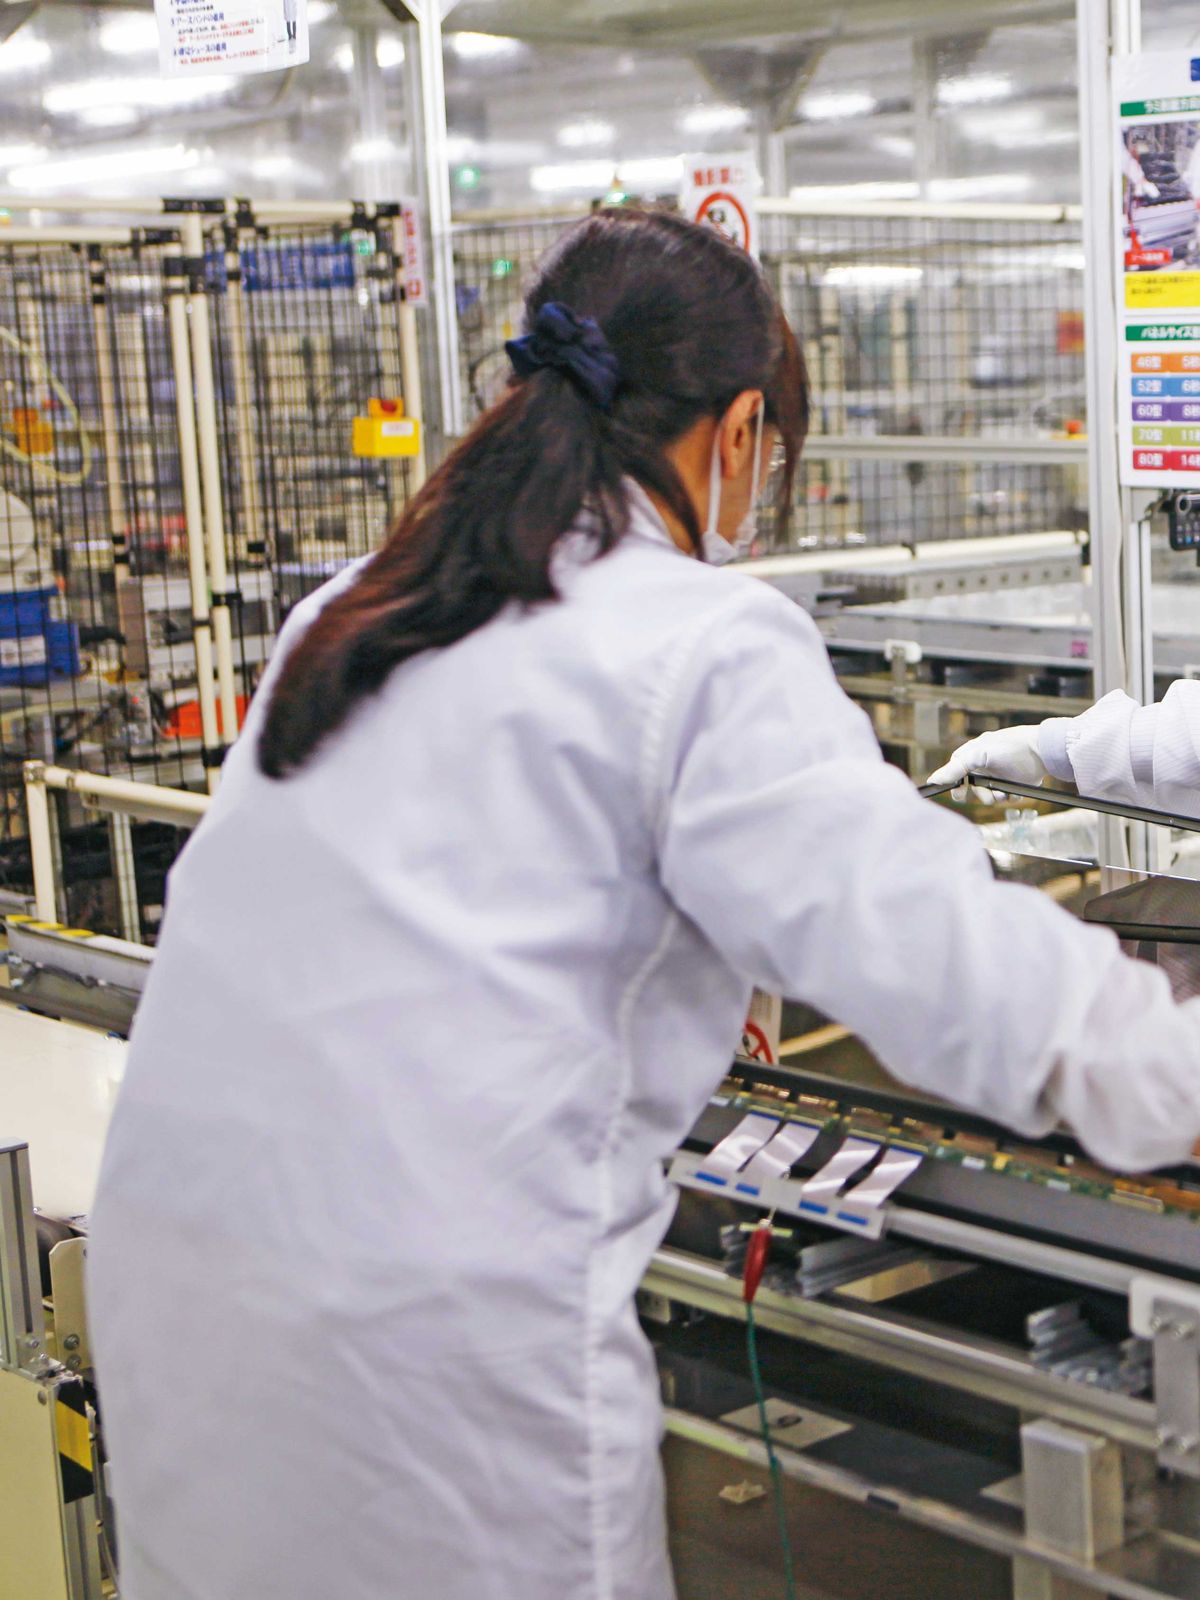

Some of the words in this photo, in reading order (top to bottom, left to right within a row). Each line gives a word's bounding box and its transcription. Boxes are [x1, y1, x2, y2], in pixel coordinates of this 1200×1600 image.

[1137, 380, 1162, 392] 52型
[1137, 405, 1163, 417] 60型
[1138, 453, 1163, 466] 80型
